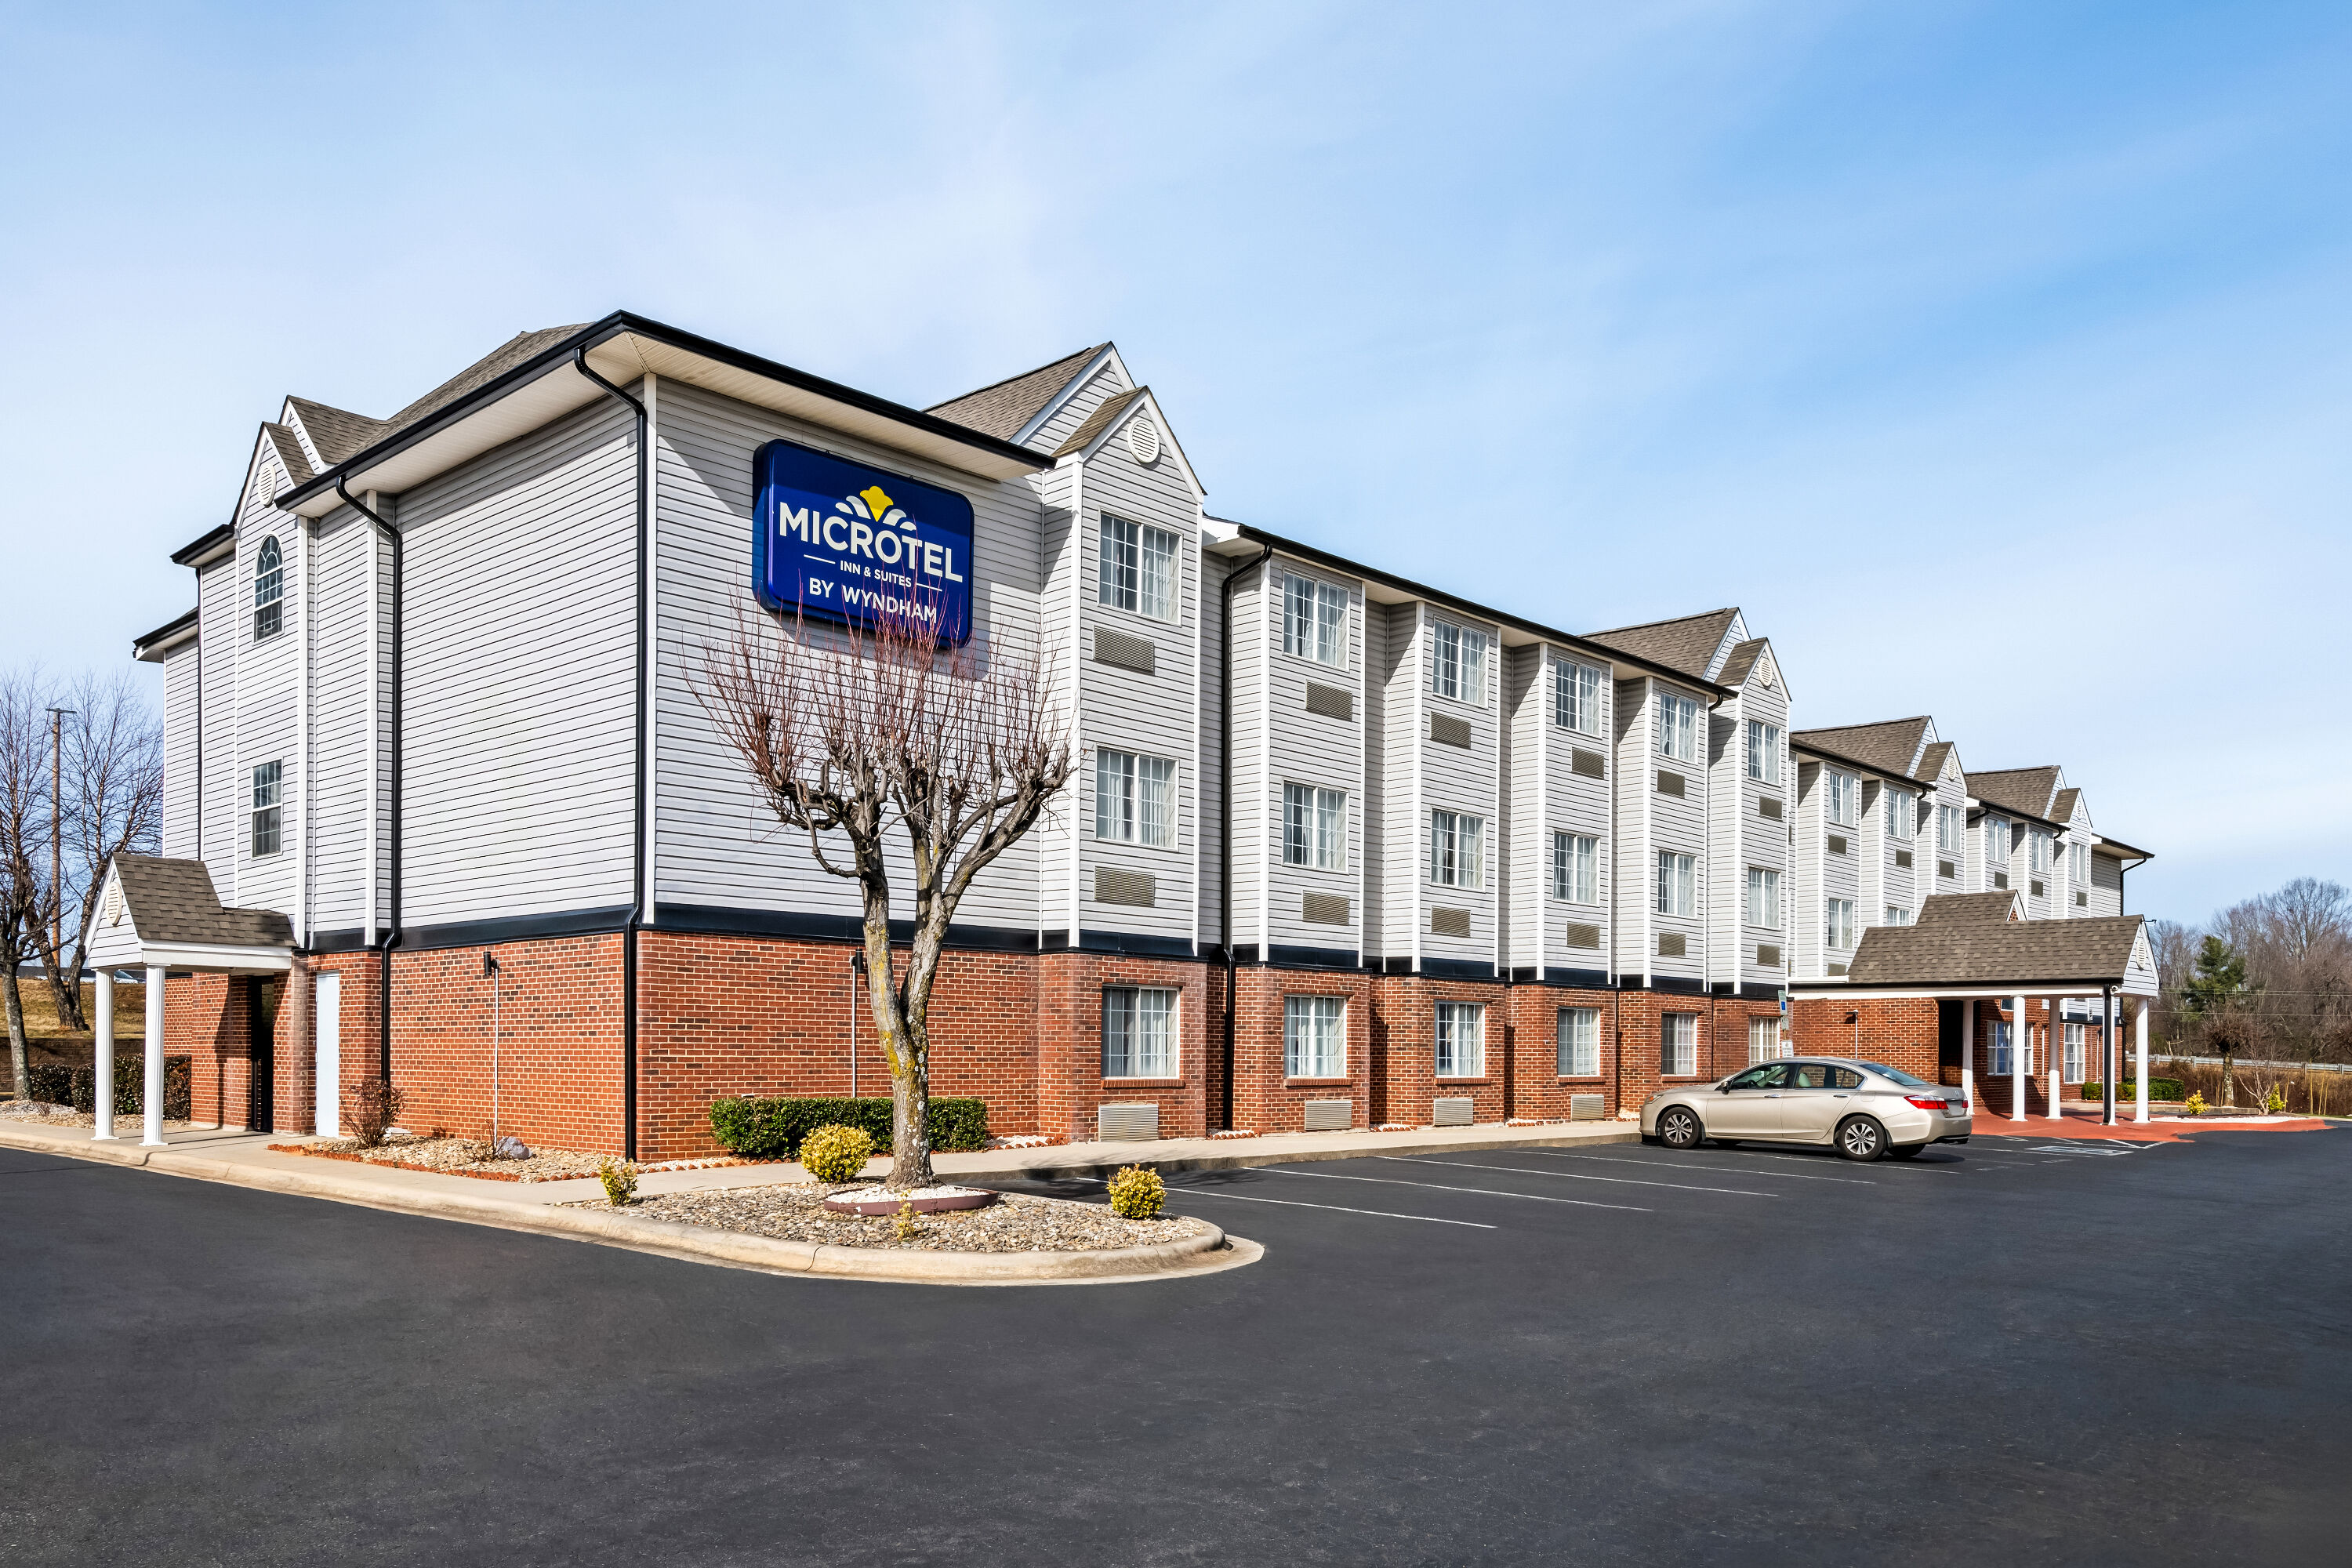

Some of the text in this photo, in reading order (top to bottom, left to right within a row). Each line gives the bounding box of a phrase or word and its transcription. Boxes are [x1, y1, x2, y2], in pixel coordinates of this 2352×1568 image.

[779, 502, 963, 583] MICROTEL
[840, 560, 912, 588] INN & SUITES
[809, 577, 937, 624] BY WYNDHAM
